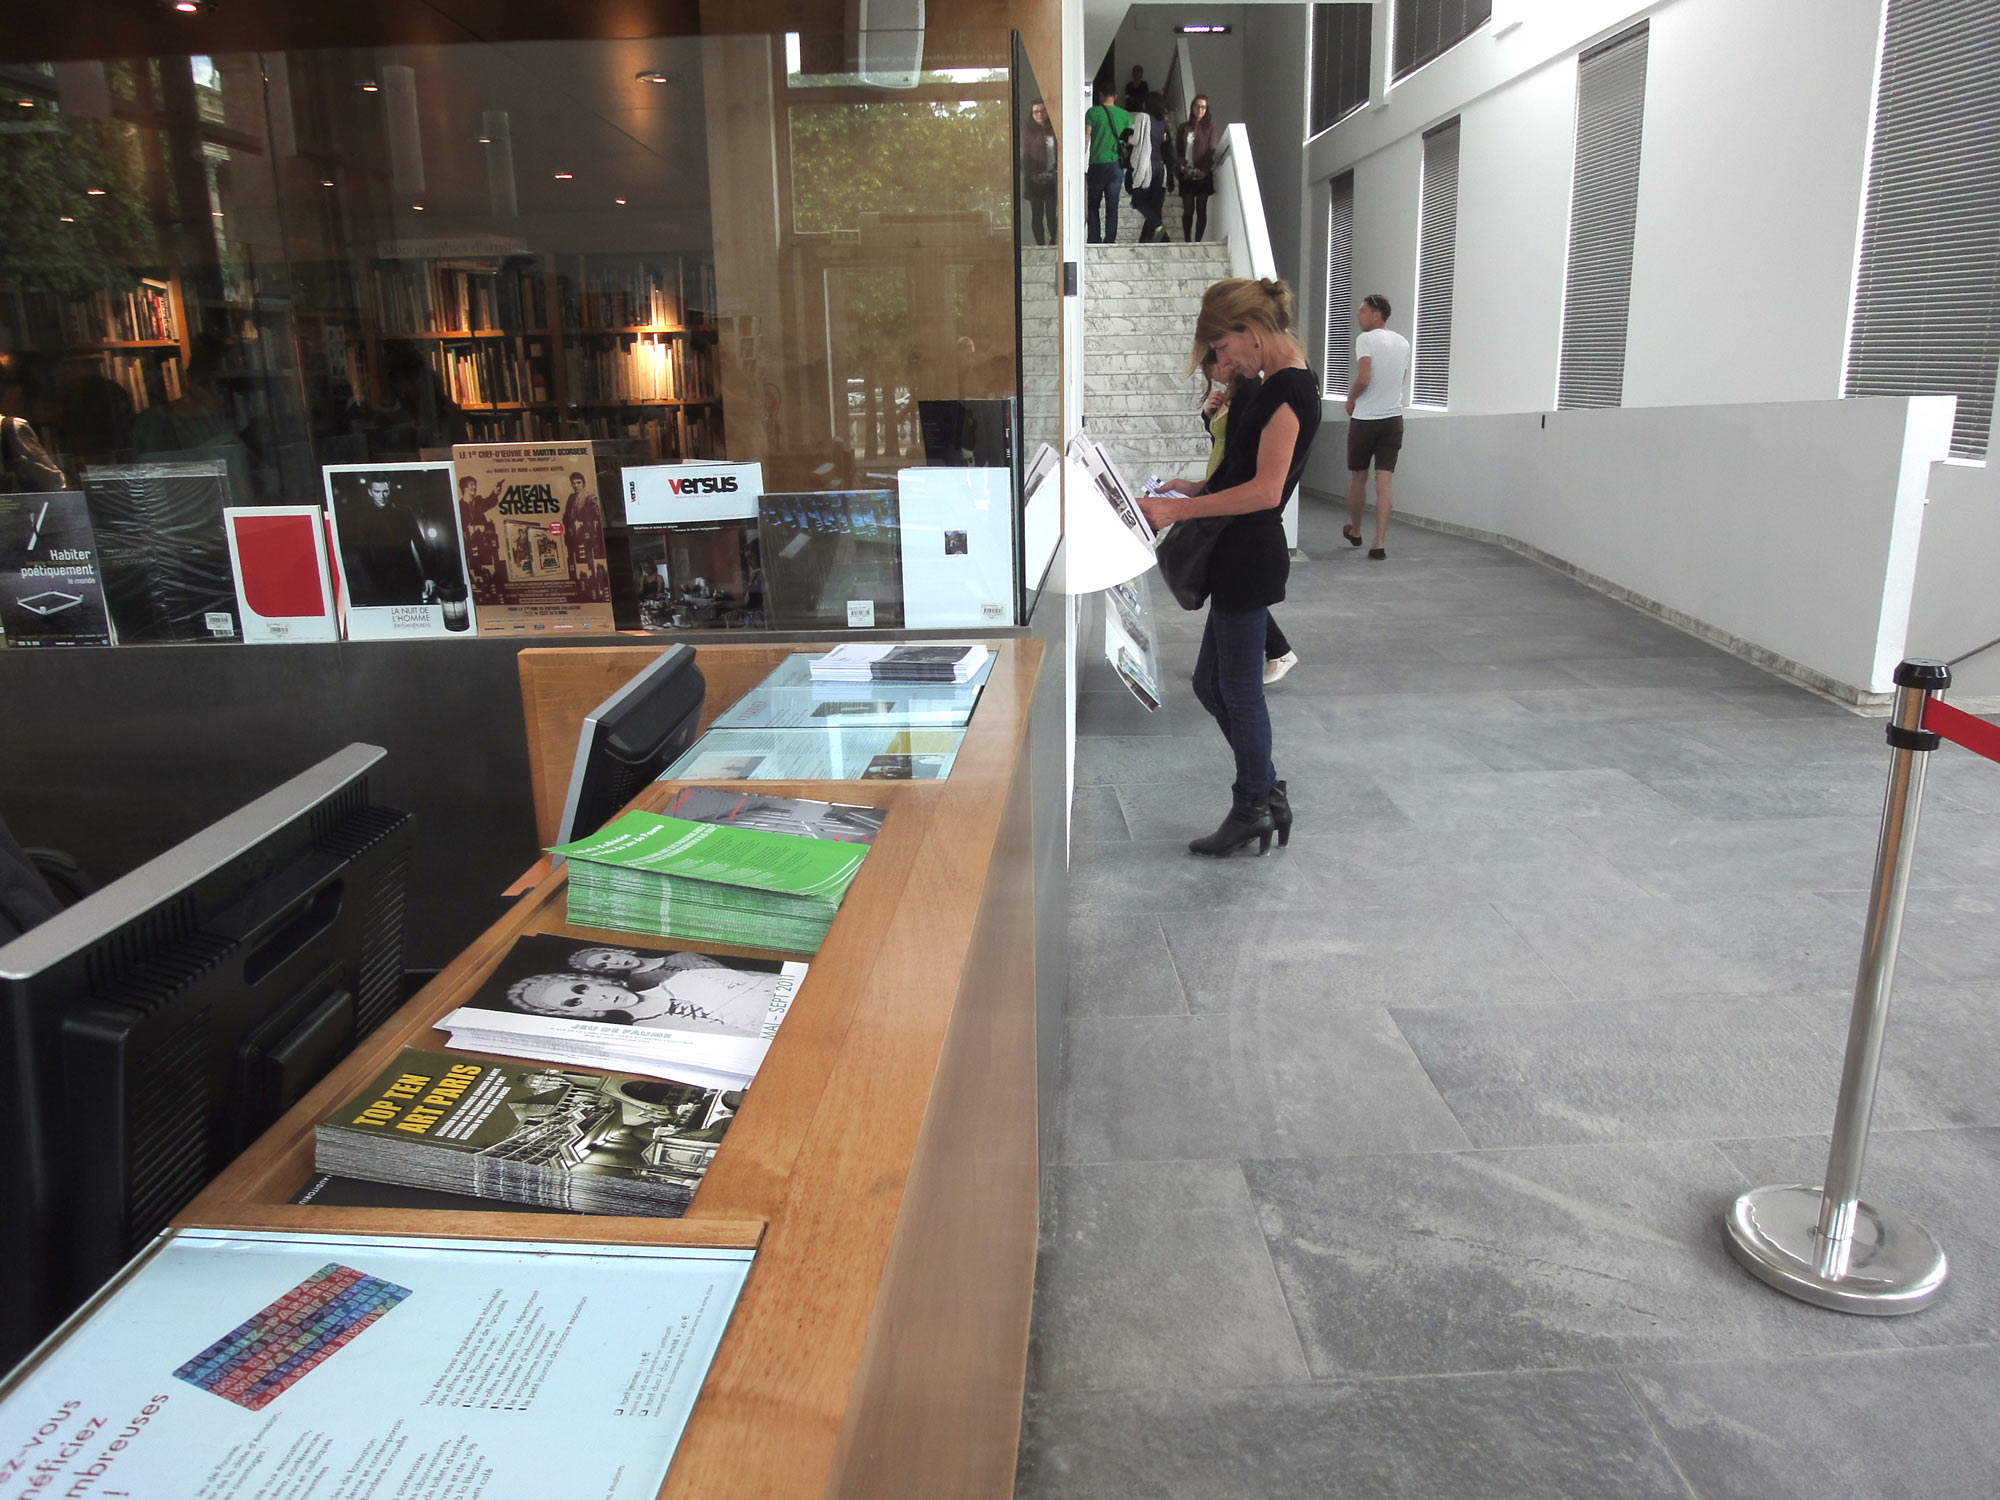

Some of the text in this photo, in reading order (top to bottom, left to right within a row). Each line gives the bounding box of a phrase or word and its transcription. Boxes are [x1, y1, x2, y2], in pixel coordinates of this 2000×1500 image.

[524, 449, 532, 457] DE
[533, 448, 556, 457] MARTIN
[557, 447, 588, 456] SCORSESE
[504, 484, 552, 500] MEAN
[629, 481, 642, 503] versus
[668, 476, 739, 495] versus
[499, 499, 560, 515] STREETS
[49, 550, 91, 561] Habiter
[20, 565, 94, 579] poétiquement
[392, 614, 430, 622] L'HOMME
[401, 607, 418, 615] NUIT
[419, 606, 430, 614] DE
[760, 974, 796, 1041] MAI SEPT 2011
[600, 1026, 619, 1034] DE
[622, 1029, 673, 1039] PAUME
[352, 1073, 432, 1126] TOP TEN
[395, 1105, 446, 1134] ART
[422, 1064, 483, 1106] PARIS
[567, 1296, 589, 1325] exposition
[553, 1325, 573, 1349] chaque
[472, 1361, 497, 1395] newsletter
[495, 1329, 517, 1355] abonnés
[475, 1306, 545, 1408] les offres réservées aux adhérents
[499, 1363, 524, 1396] newsletter
[518, 1322, 548, 1362] d'information
[547, 1349, 560, 1358] de
[435, 1393, 450, 1406] des
[445, 1374, 462, 1392] offres
[457, 1344, 481, 1373] spéciales
[479, 1328, 491, 1336] de
[449, 1336, 500, 1406] du Jeu de Paume avec
[505, 1330, 556, 1406] le programme trimestriel
[534, 1359, 554, 1382] journal
[649, 1378, 662, 1391] duo
[658, 1359, 671, 1372] duo
[419, 1389, 439, 1405] Vous
[443, 1357, 459, 1373] aussi
[527, 1383, 541, 1398] petit
[64, 1394, 169, 1499] mbreuses
[232, 1450, 252, 1468] date
[361, 1469, 372, 1477] et
[368, 1418, 405, 1468] contemporain
[384, 1435, 409, 1467] annuelle
[221, 1469, 237, 1478] la
[231, 1450, 267, 1490] avantages
[339, 1438, 378, 1485] de formation
[395, 1452, 428, 1496] partenaires
[413, 1439, 452, 1491] abonnements,
[427, 1465, 450, 1488] billets
[443, 1434, 468, 1465] d'entrée
[453, 1462, 467, 1473] de
[461, 1455, 486, 1483] librairie
[215, 1479, 229, 1489] de
[450, 1474, 460, 1482] et
[455, 1485, 469, 1493] la
[479, 1468, 494, 1485] café
